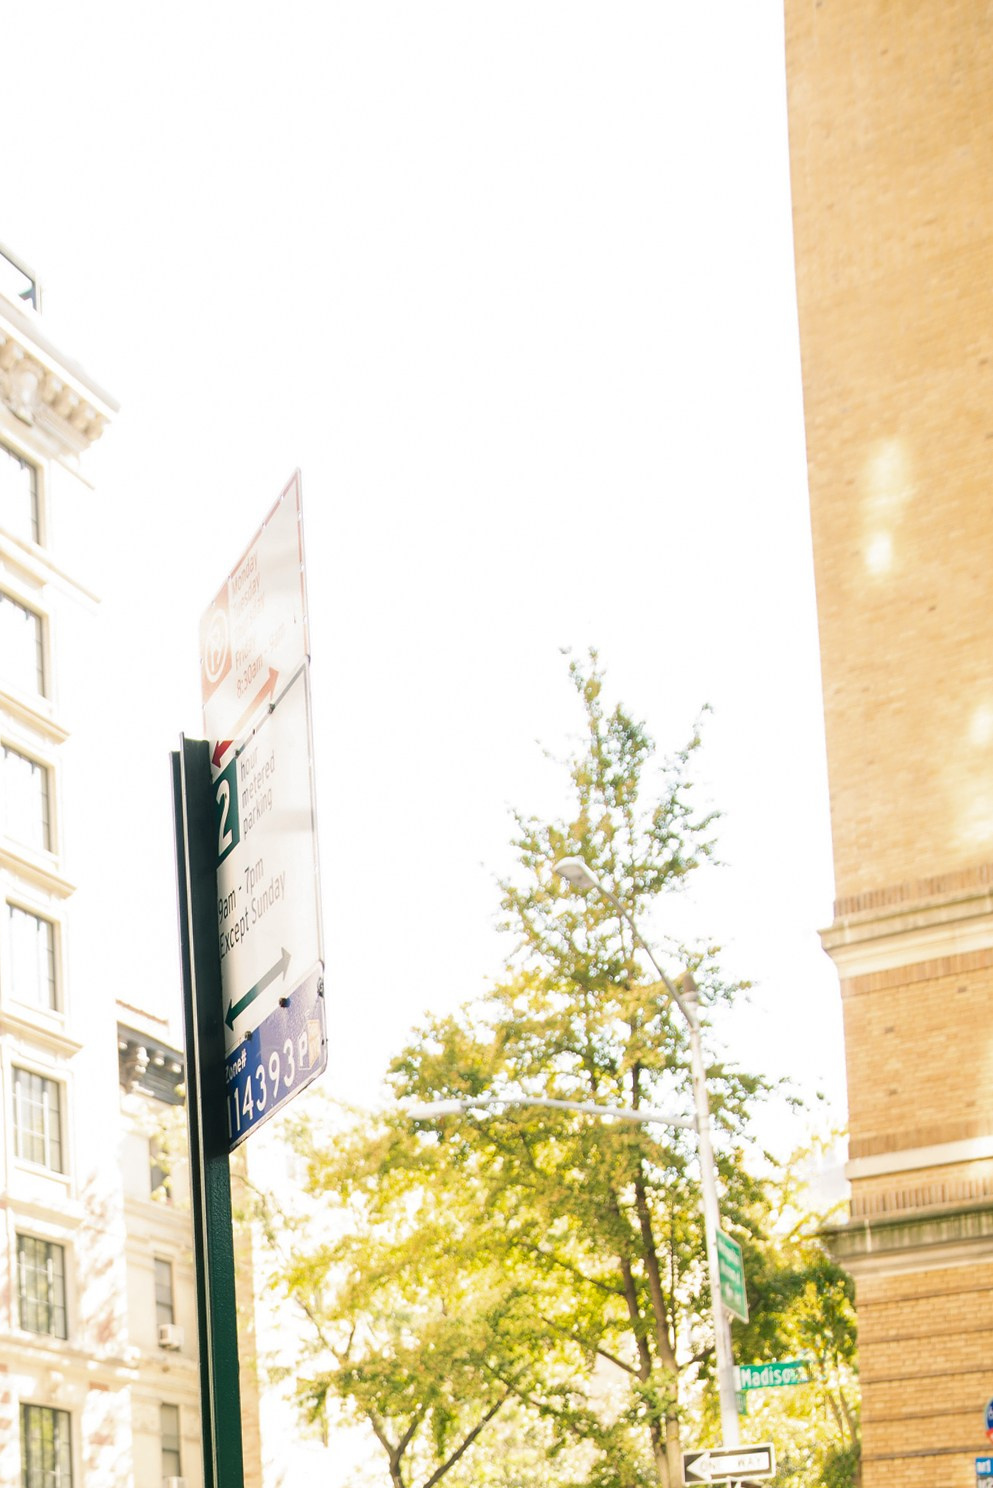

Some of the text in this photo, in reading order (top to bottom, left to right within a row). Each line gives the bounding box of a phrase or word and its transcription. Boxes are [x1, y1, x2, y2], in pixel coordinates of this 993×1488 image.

[232, 551, 258, 592] Monday
[237, 654, 263, 699] 8:30am
[241, 747, 258, 782] hour
[242, 749, 275, 809] metered
[216, 779, 233, 857] 2
[244, 788, 273, 840] parking
[219, 889, 236, 924] 9am
[244, 857, 264, 894] 7pm
[219, 870, 286, 959] Except Sunday
